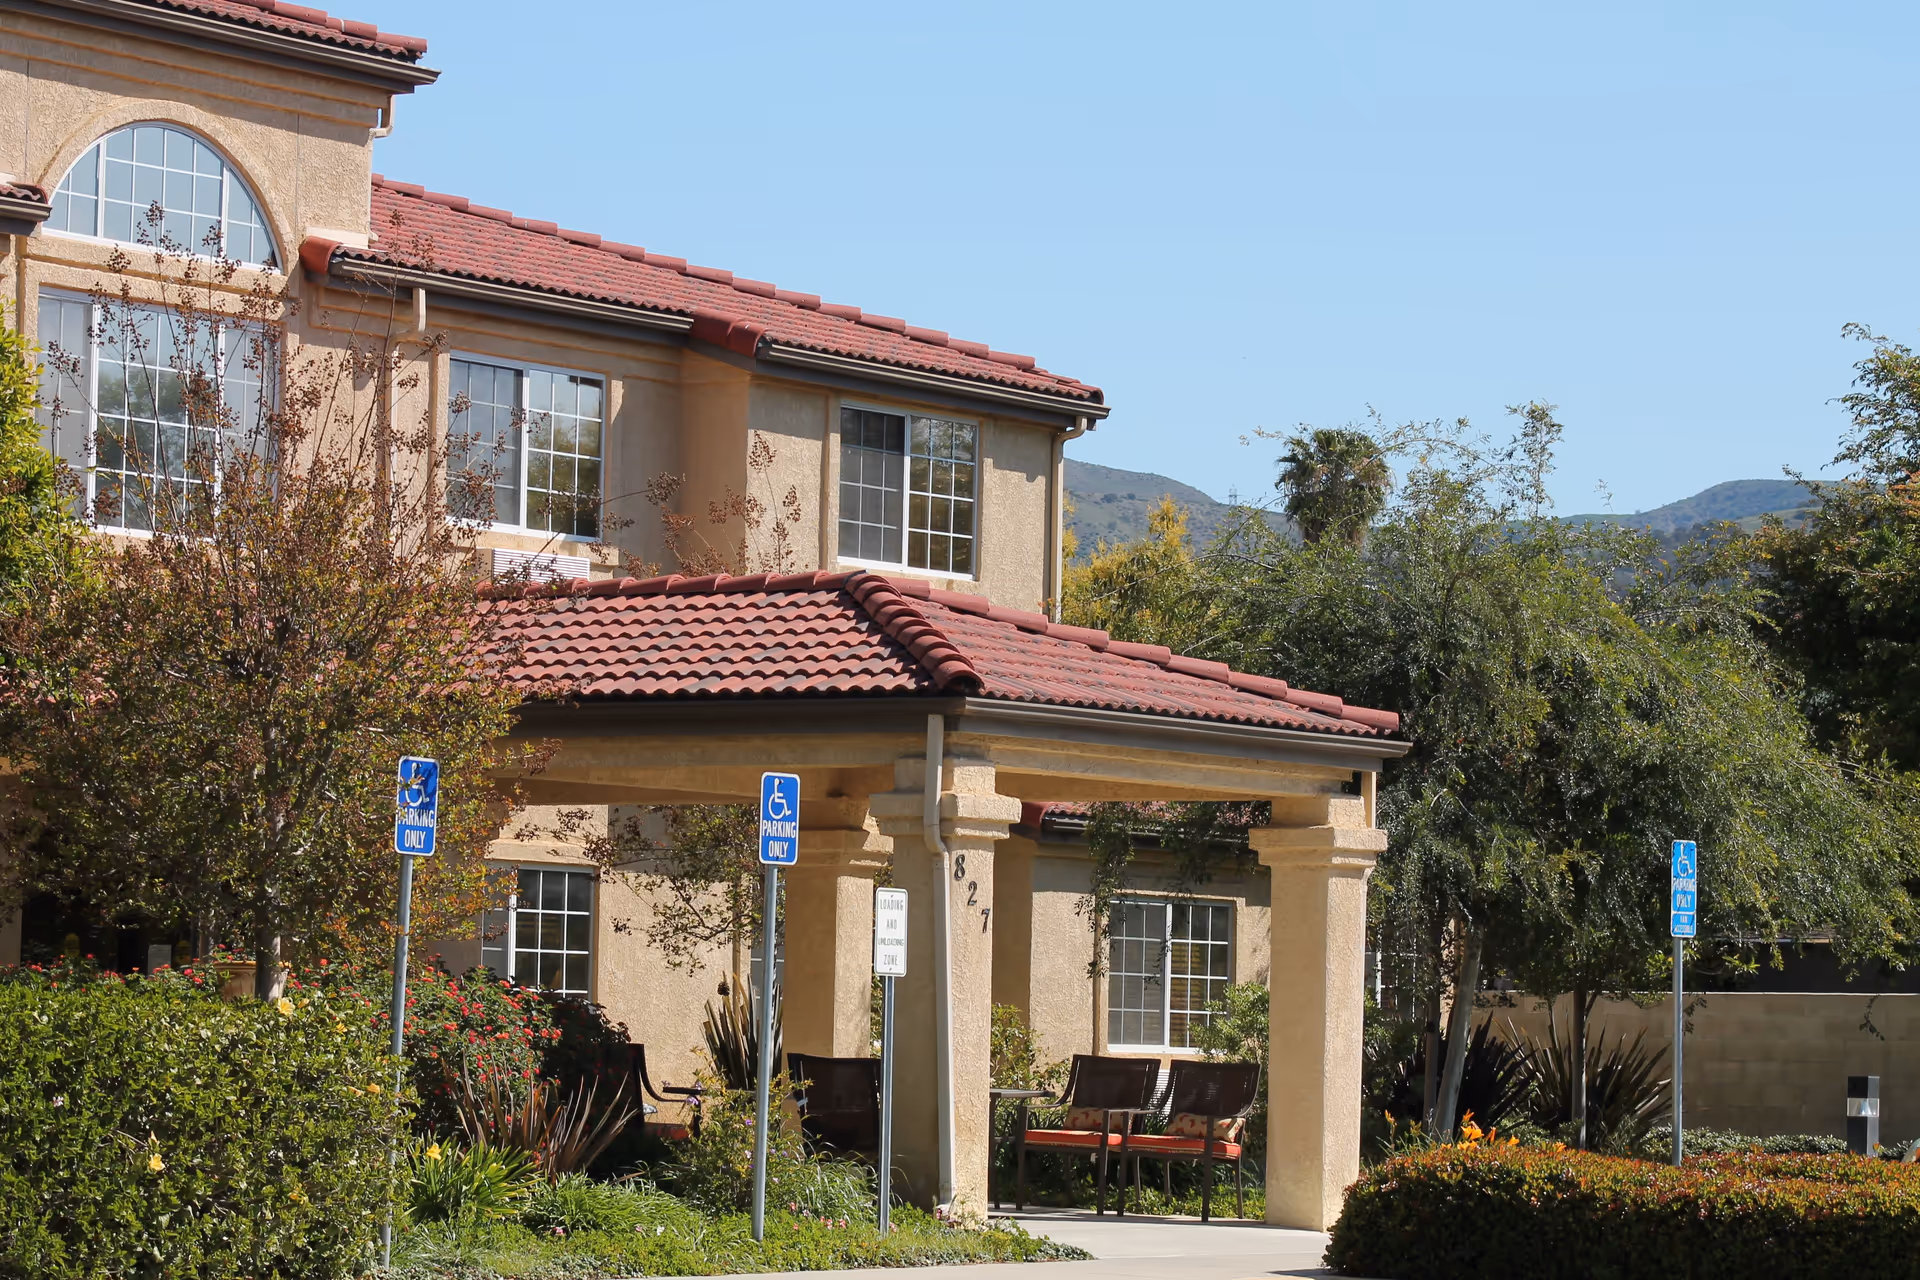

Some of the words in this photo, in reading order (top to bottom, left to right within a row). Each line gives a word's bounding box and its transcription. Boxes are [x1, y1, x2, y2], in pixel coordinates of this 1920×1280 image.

[762, 820, 796, 838] PARKING
[404, 829, 426, 848] ONLY
[768, 840, 789, 858] ONLY
[954, 854, 990, 933] 827
[880, 899, 903, 911] LOADING
[886, 919, 897, 930] AND
[883, 954, 898, 966] ZONE
